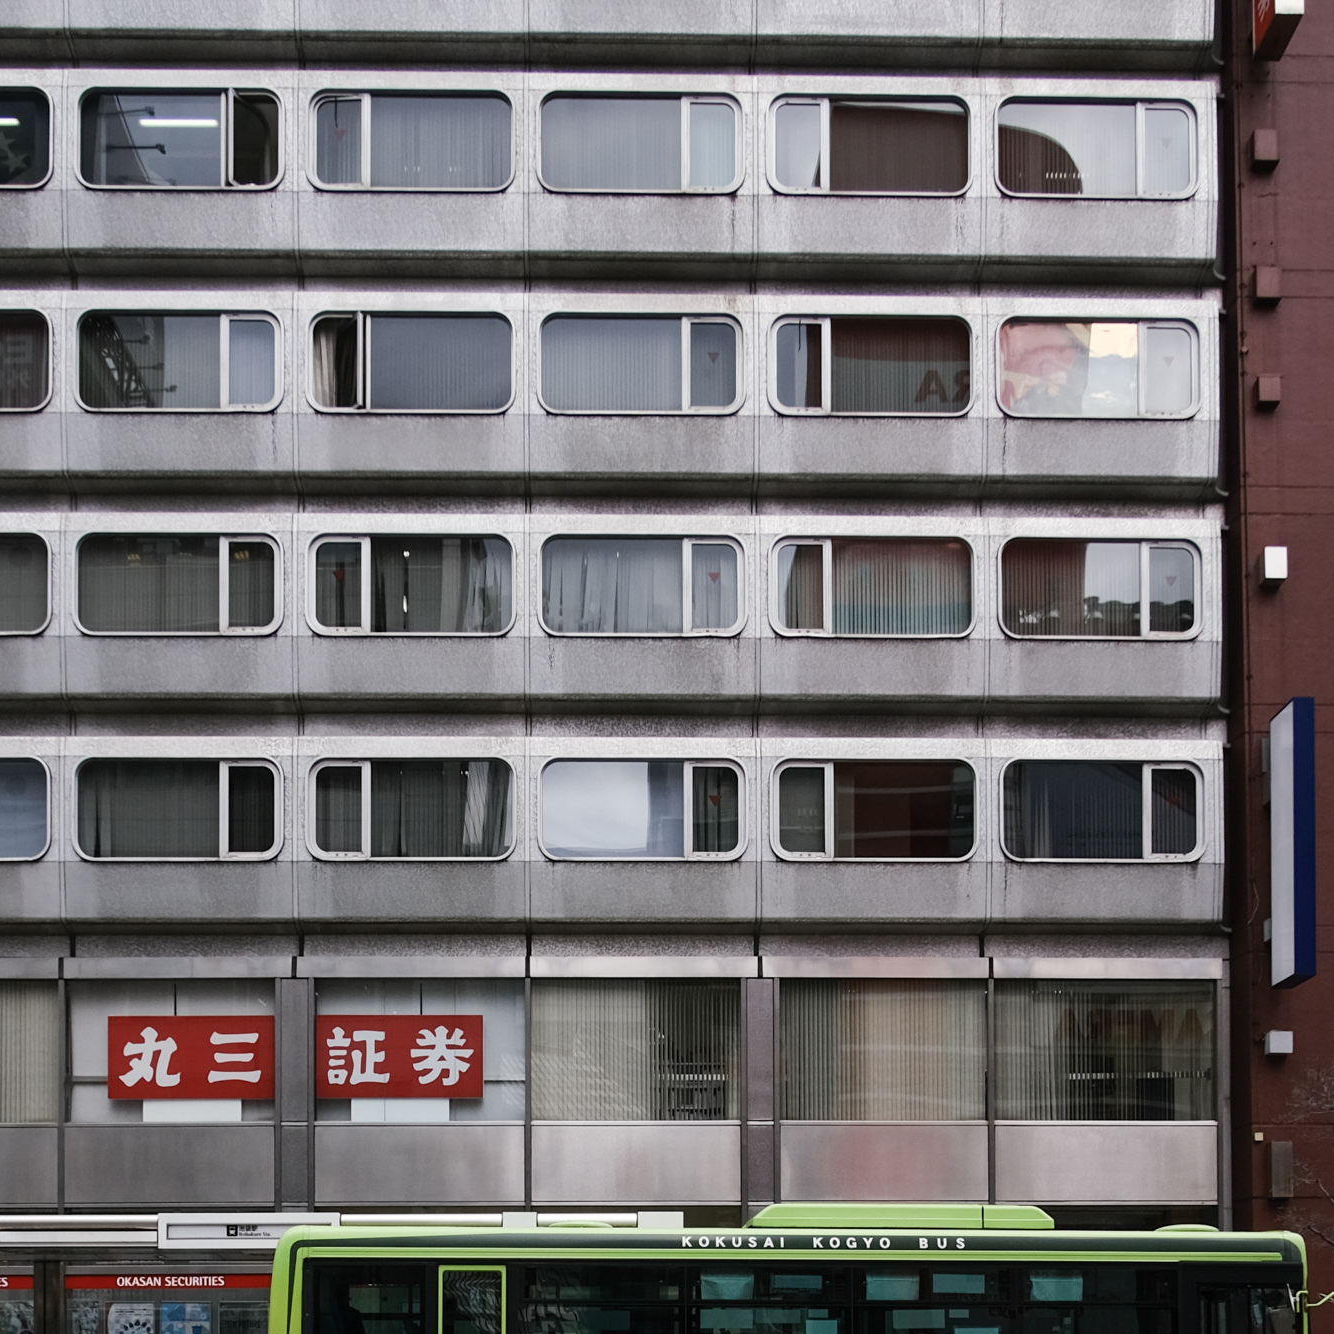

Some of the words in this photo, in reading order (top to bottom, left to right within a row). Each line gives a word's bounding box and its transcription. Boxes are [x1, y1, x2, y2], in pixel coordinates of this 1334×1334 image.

[682, 1236, 785, 1248] KOKUSAI
[813, 1237, 891, 1249] KOGYO
[919, 1237, 966, 1249] BUS
[117, 1276, 161, 1286] OKASAN
[165, 1276, 225, 1286] SECURITIES
